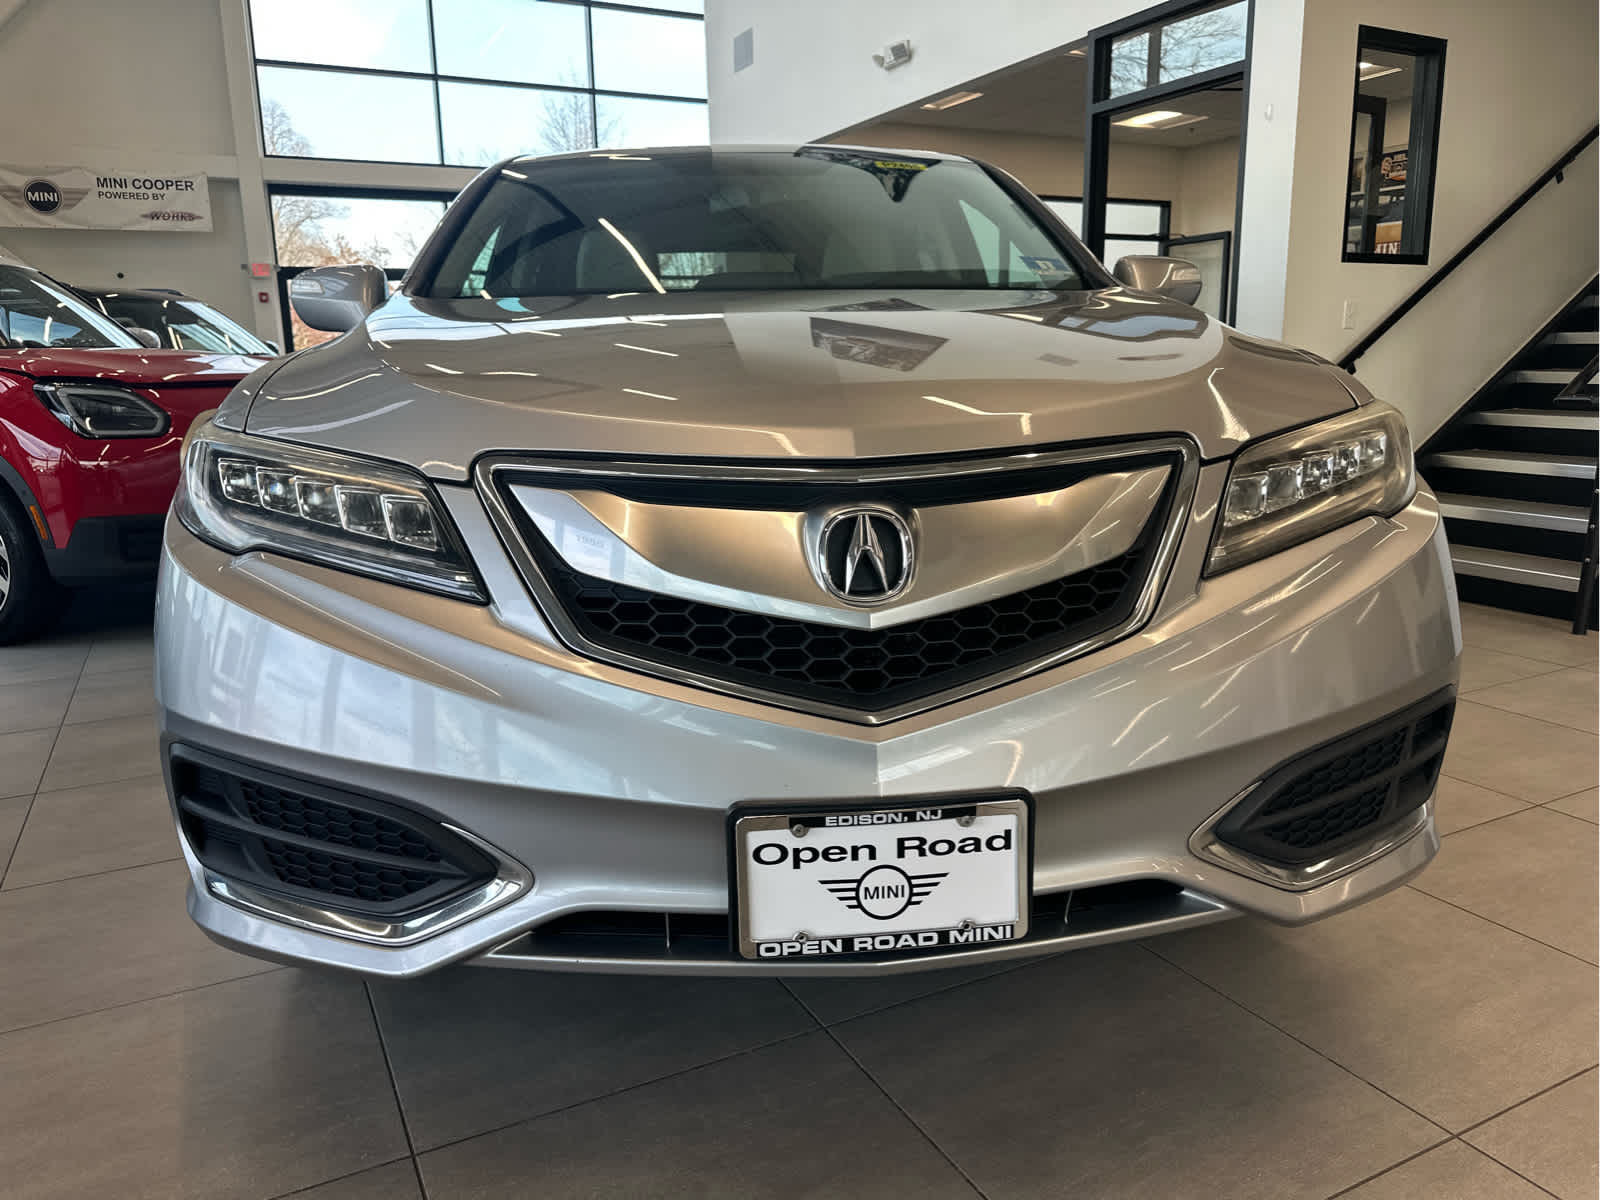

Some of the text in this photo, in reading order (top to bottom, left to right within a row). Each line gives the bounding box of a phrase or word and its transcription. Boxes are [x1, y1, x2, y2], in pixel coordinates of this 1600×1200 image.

[96, 177, 194, 191] MINI COOPER
[27, 191, 59, 202] MINI
[98, 191, 150, 200] POWERED
[825, 809, 942, 827] EDISON, NJ
[752, 829, 1013, 869] Open Road
[863, 885, 906, 900] MINI
[760, 925, 1013, 957] OPEN ROAD MINI
